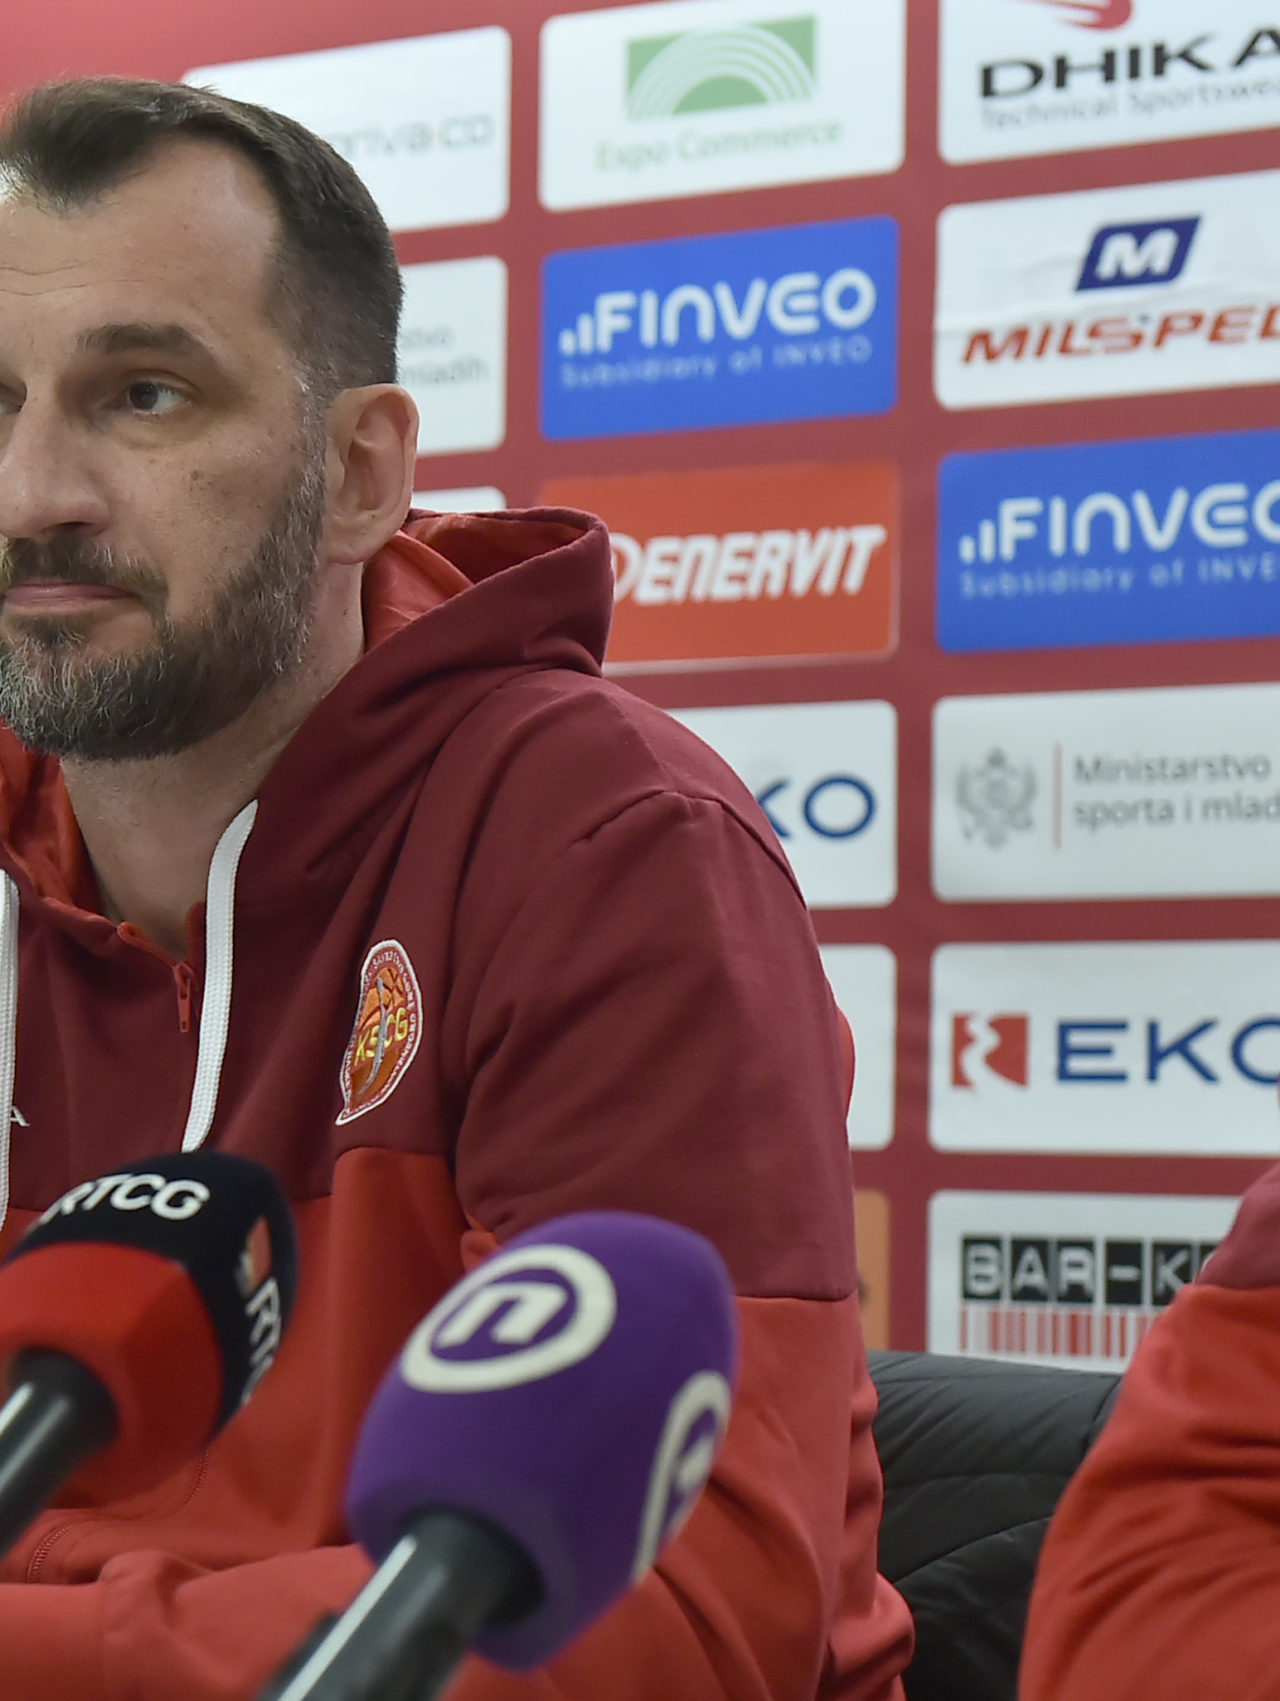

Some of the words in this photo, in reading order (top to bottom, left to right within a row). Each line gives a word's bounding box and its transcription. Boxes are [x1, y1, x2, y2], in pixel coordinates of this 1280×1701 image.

[1128, 76, 1280, 114] Sportswe
[594, 141, 670, 173] Expo
[676, 119, 844, 164] Commerce
[594, 267, 877, 354] FINVEO
[1074, 754, 1271, 785] Ministarstvo
[1074, 797, 1174, 832] sporta
[1056, 1017, 1280, 1086] EKO
[24, 1172, 211, 1234] RTCG
[962, 1237, 1225, 1302] BAR-K
